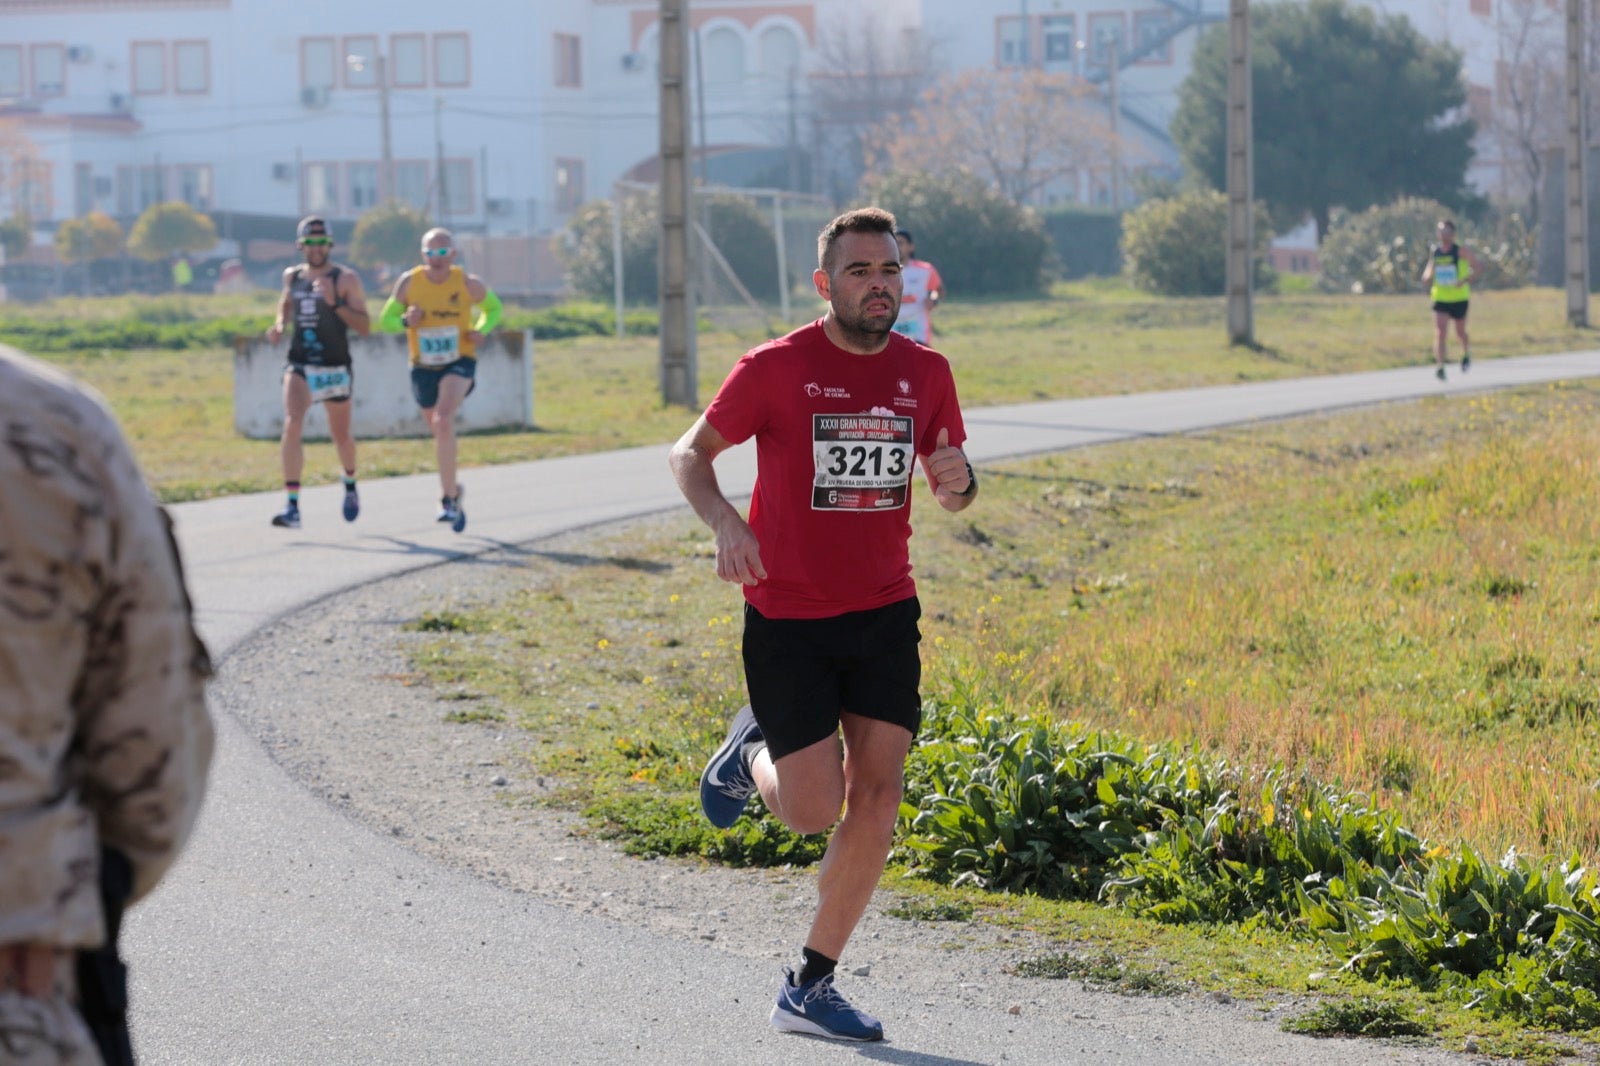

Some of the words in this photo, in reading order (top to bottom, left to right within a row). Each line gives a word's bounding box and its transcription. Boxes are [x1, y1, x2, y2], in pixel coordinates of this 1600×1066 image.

[820, 418, 838, 430] XXXII
[840, 418, 857, 430] GRAN
[858, 418, 880, 430] PREMIO
[882, 420, 890, 430] DE
[891, 420, 907, 432] FONDO
[828, 446, 905, 476] 3213
